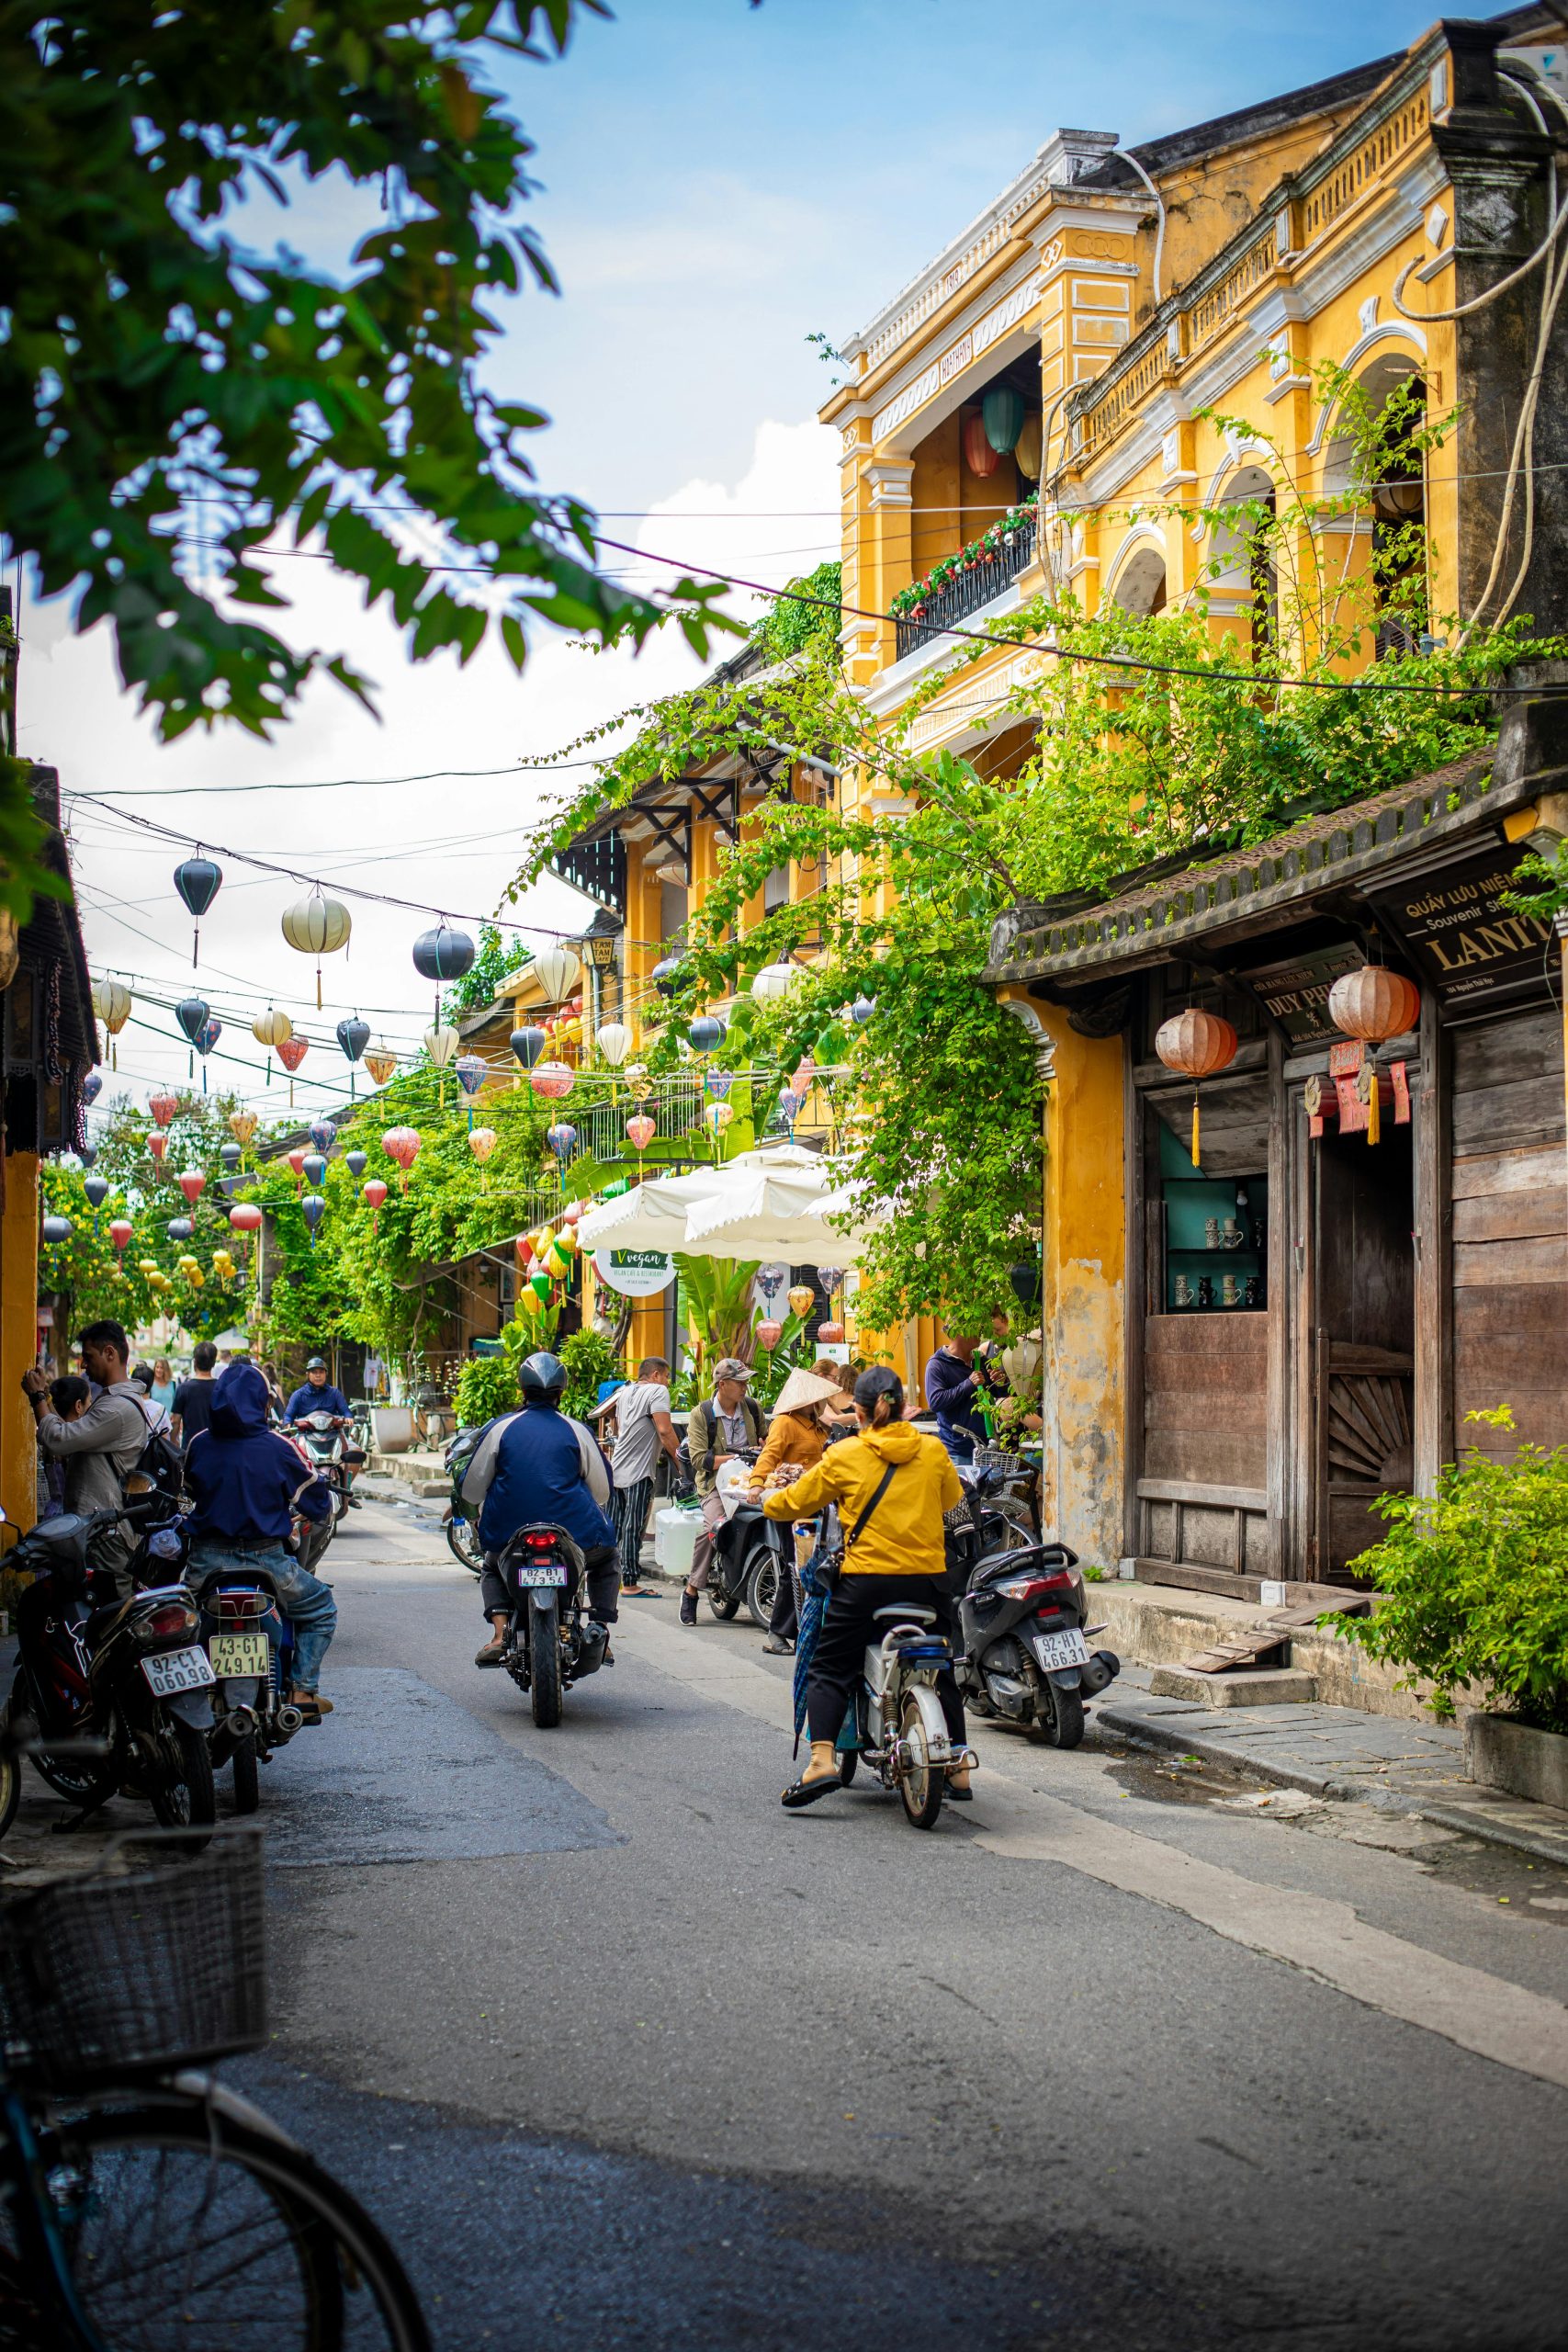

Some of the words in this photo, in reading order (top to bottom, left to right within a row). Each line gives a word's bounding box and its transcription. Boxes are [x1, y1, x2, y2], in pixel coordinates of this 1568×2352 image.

[1426, 906, 1483, 932] Souvenir
[1265, 993, 1303, 1016] DUY
[219, 1637, 258, 1656] 43-G1
[1042, 1633, 1077, 1652] 92-H1
[152, 1651, 197, 1675] 92-C1
[213, 1656, 265, 1676] 249.14
[1043, 1647, 1086, 1668] 466.31
[152, 1666, 210, 1692] 060.98
